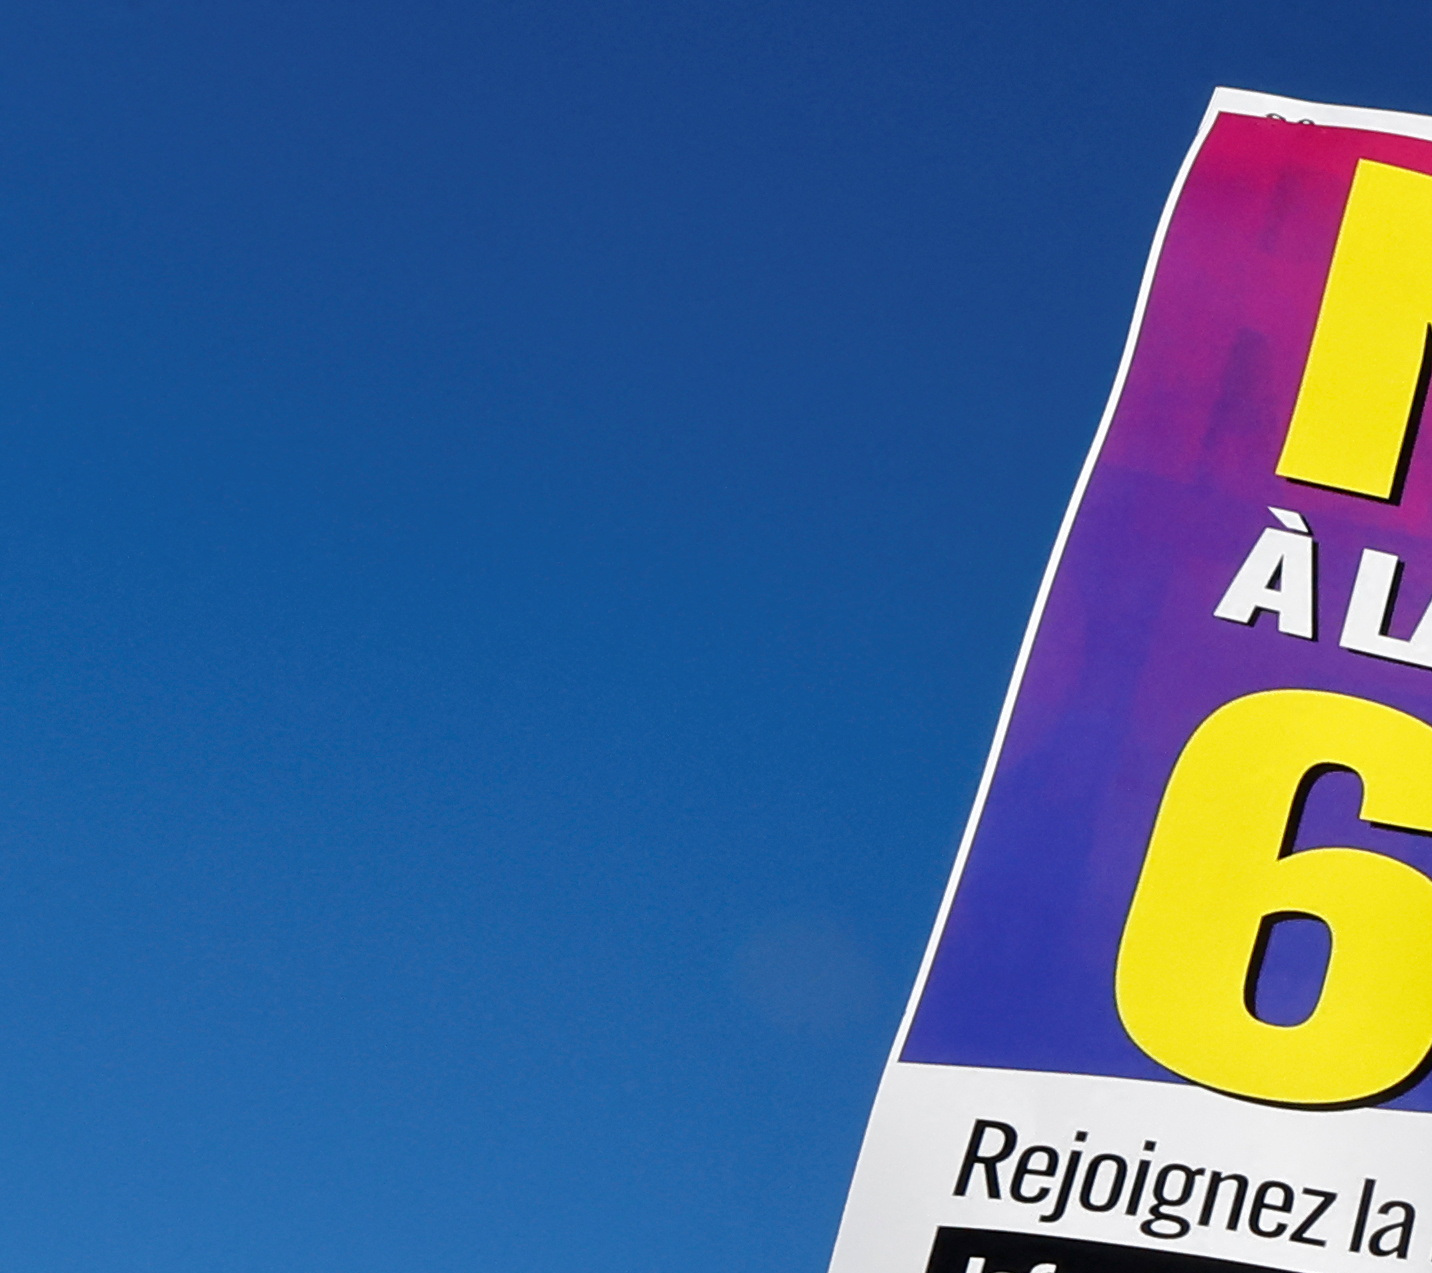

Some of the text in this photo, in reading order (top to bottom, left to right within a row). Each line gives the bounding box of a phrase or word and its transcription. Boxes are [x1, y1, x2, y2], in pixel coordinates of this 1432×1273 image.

[1217, 509, 1315, 637] À
[953, 1118, 1337, 1246] Rejoignez
[1352, 1178, 1405, 1258] la
